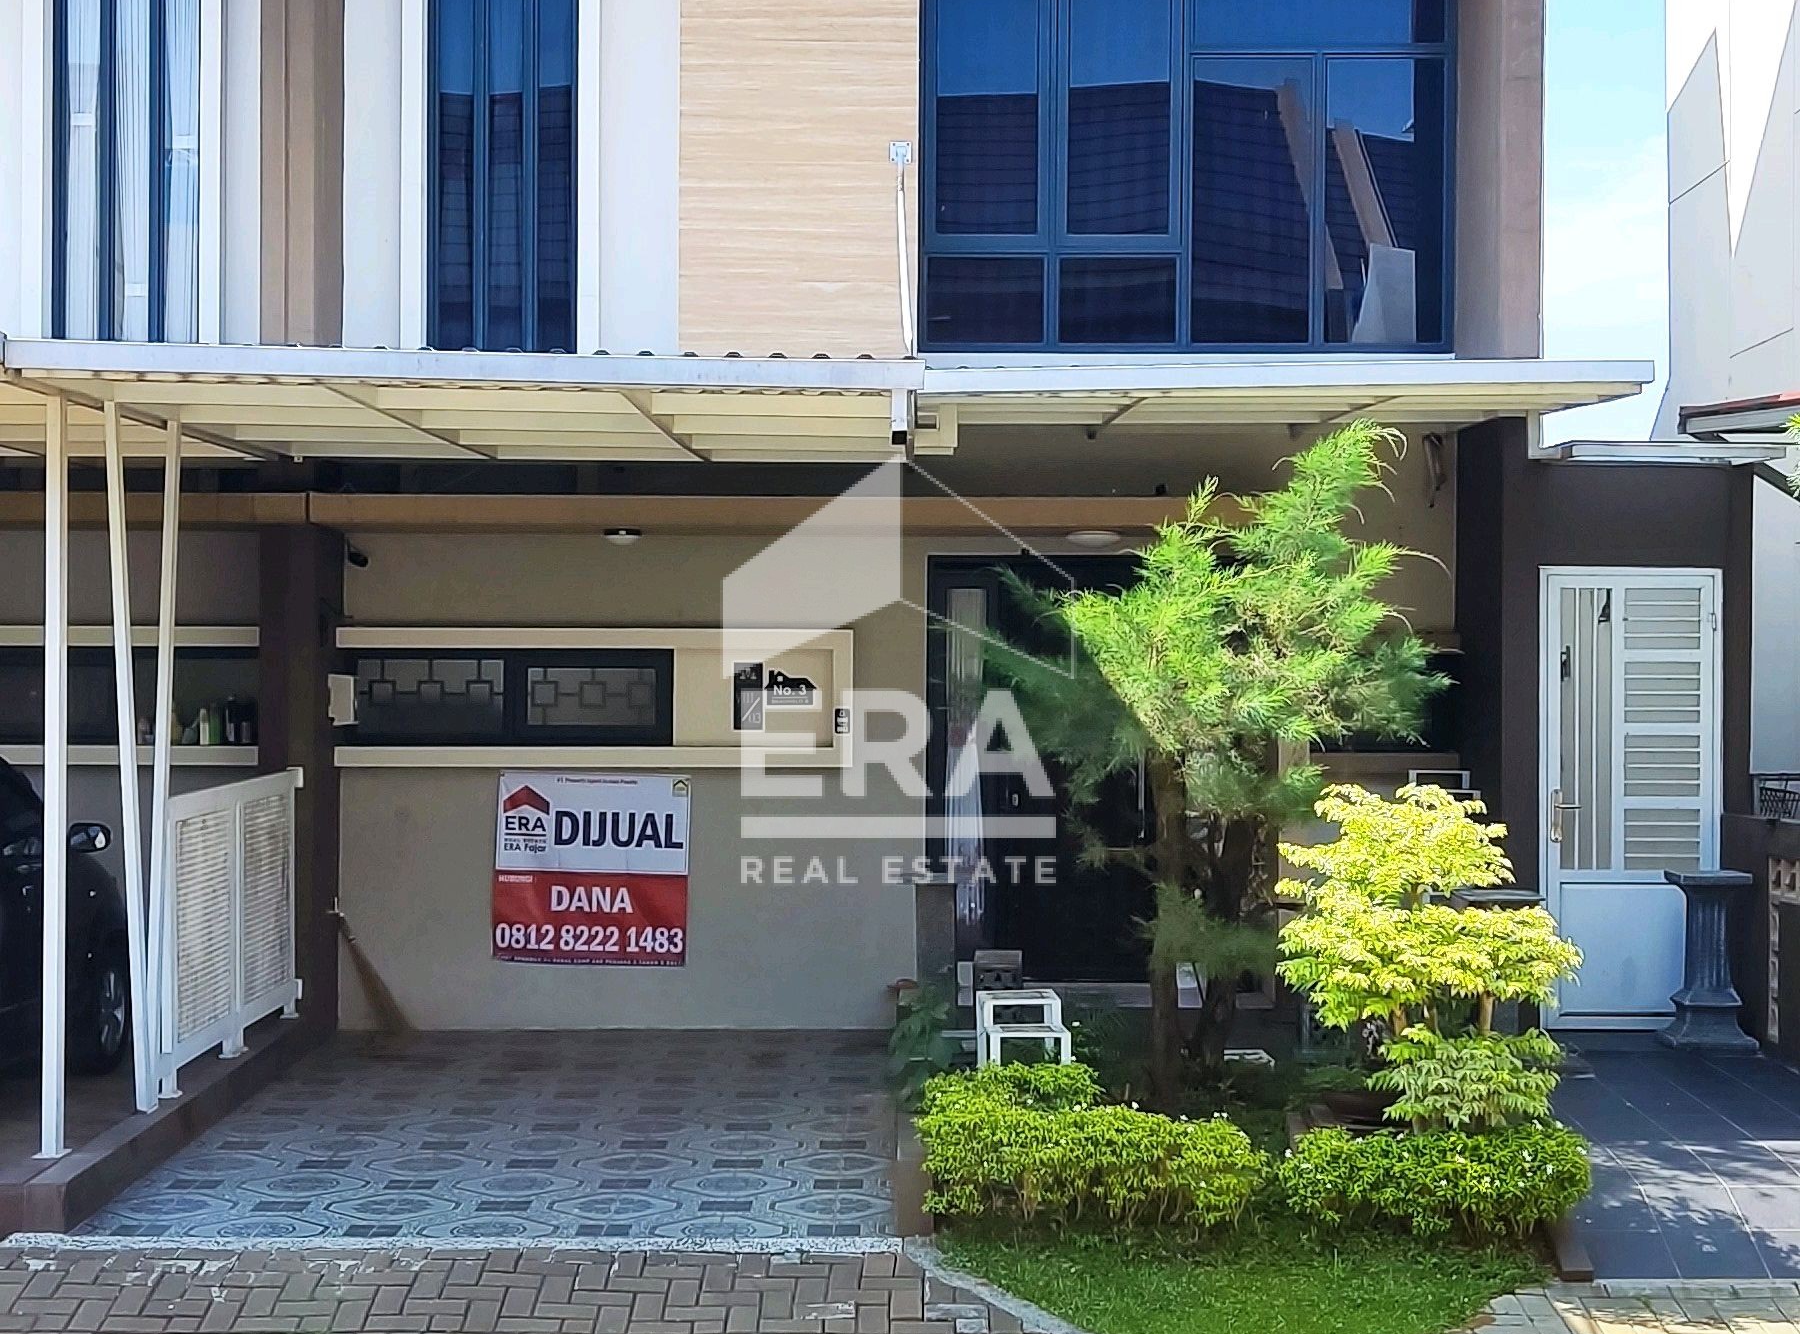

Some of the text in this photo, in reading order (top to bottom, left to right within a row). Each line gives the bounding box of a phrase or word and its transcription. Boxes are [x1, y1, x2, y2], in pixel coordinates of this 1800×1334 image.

[773, 684, 807, 696] No. 3
[505, 815, 547, 832] ERA
[553, 810, 684, 850] DIJUAL
[503, 842, 547, 854] ERA Fajar
[550, 885, 634, 914] DANA
[495, 922, 684, 954] 0812 8222 1483
